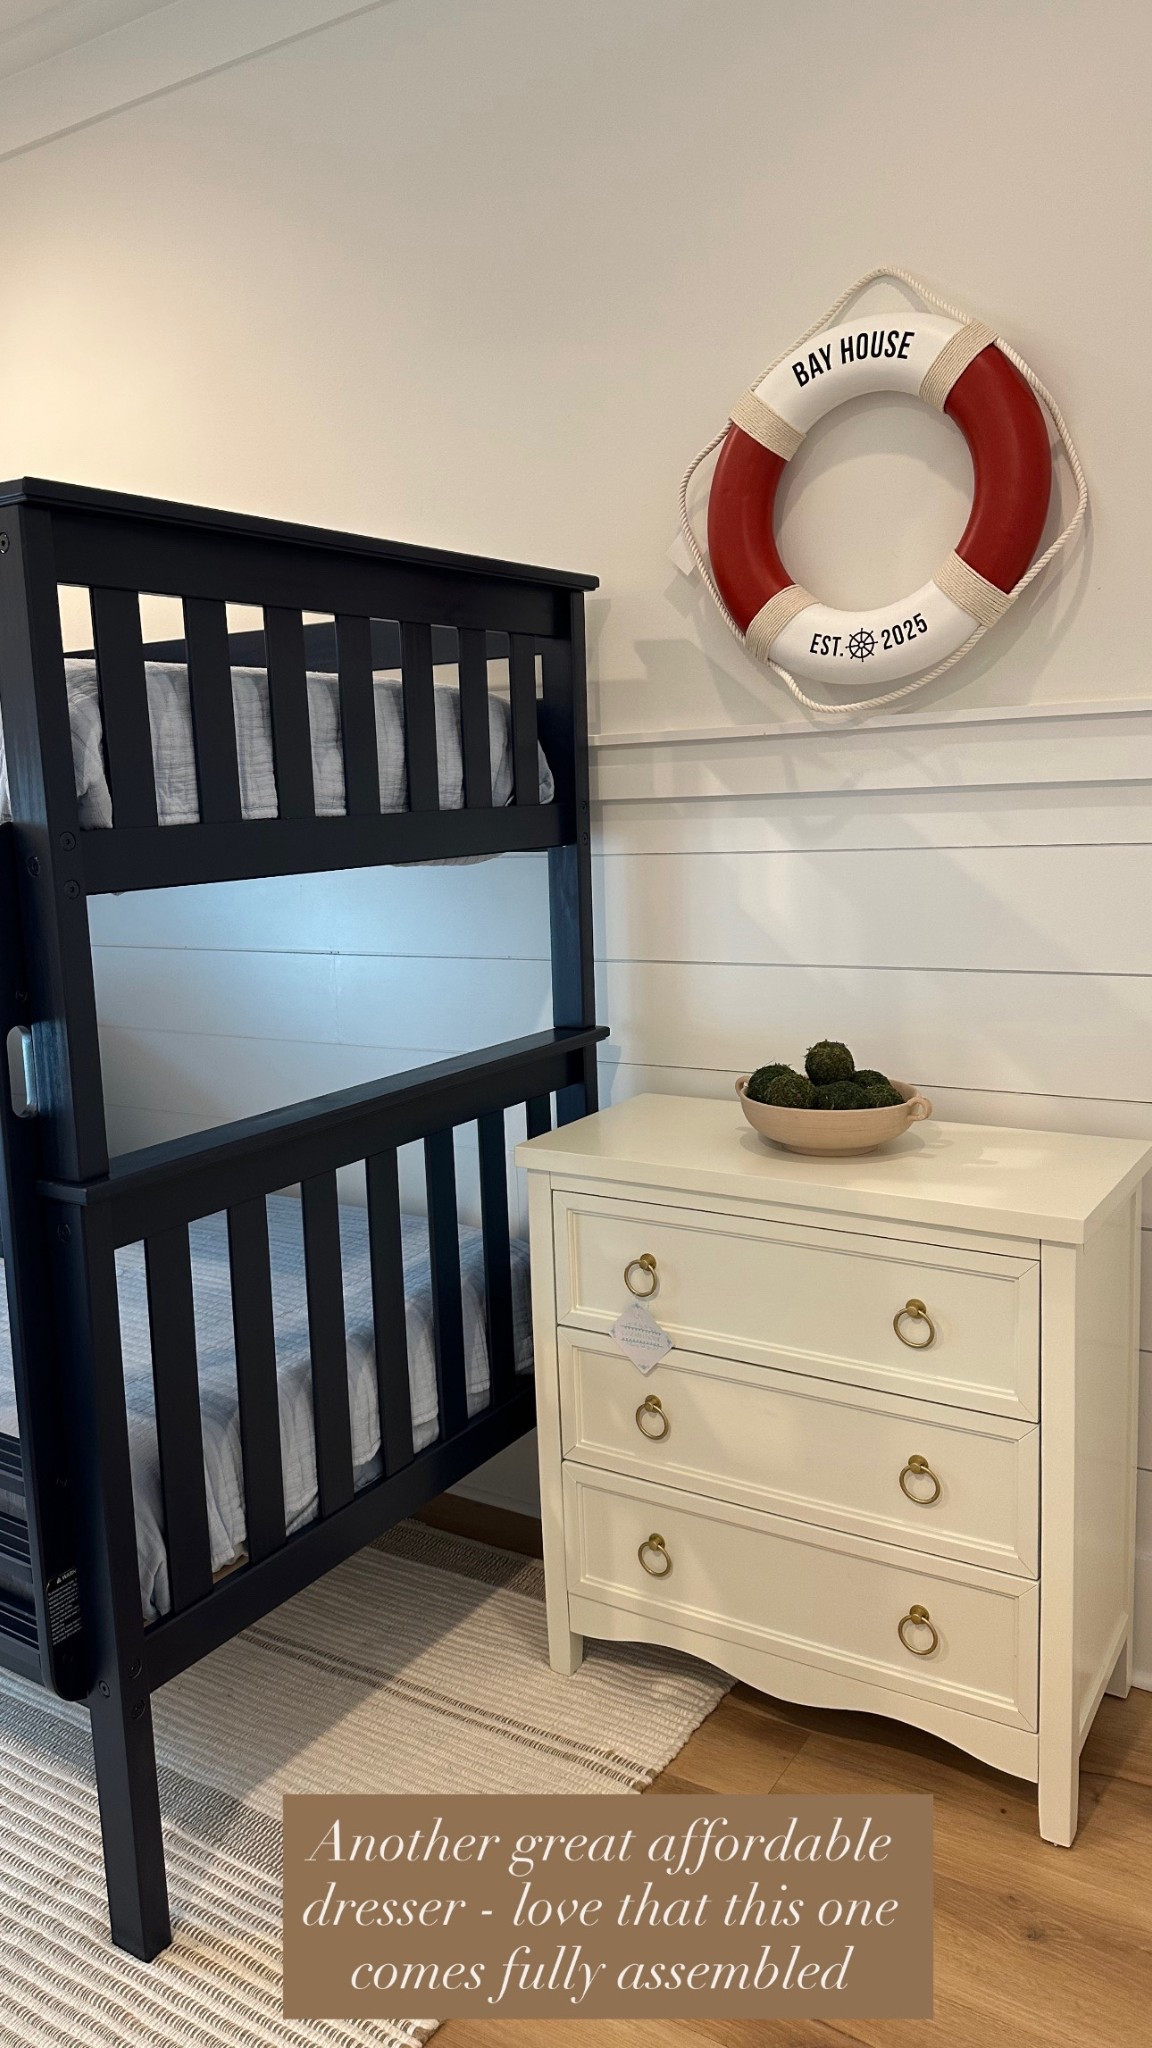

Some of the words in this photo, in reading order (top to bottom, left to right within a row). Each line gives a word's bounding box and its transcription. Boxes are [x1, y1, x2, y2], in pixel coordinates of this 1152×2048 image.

[791, 343, 832, 388] BAY
[840, 330, 915, 365] HOUSE
[809, 632, 844, 657] EST.
[881, 612, 928, 650] 2025
